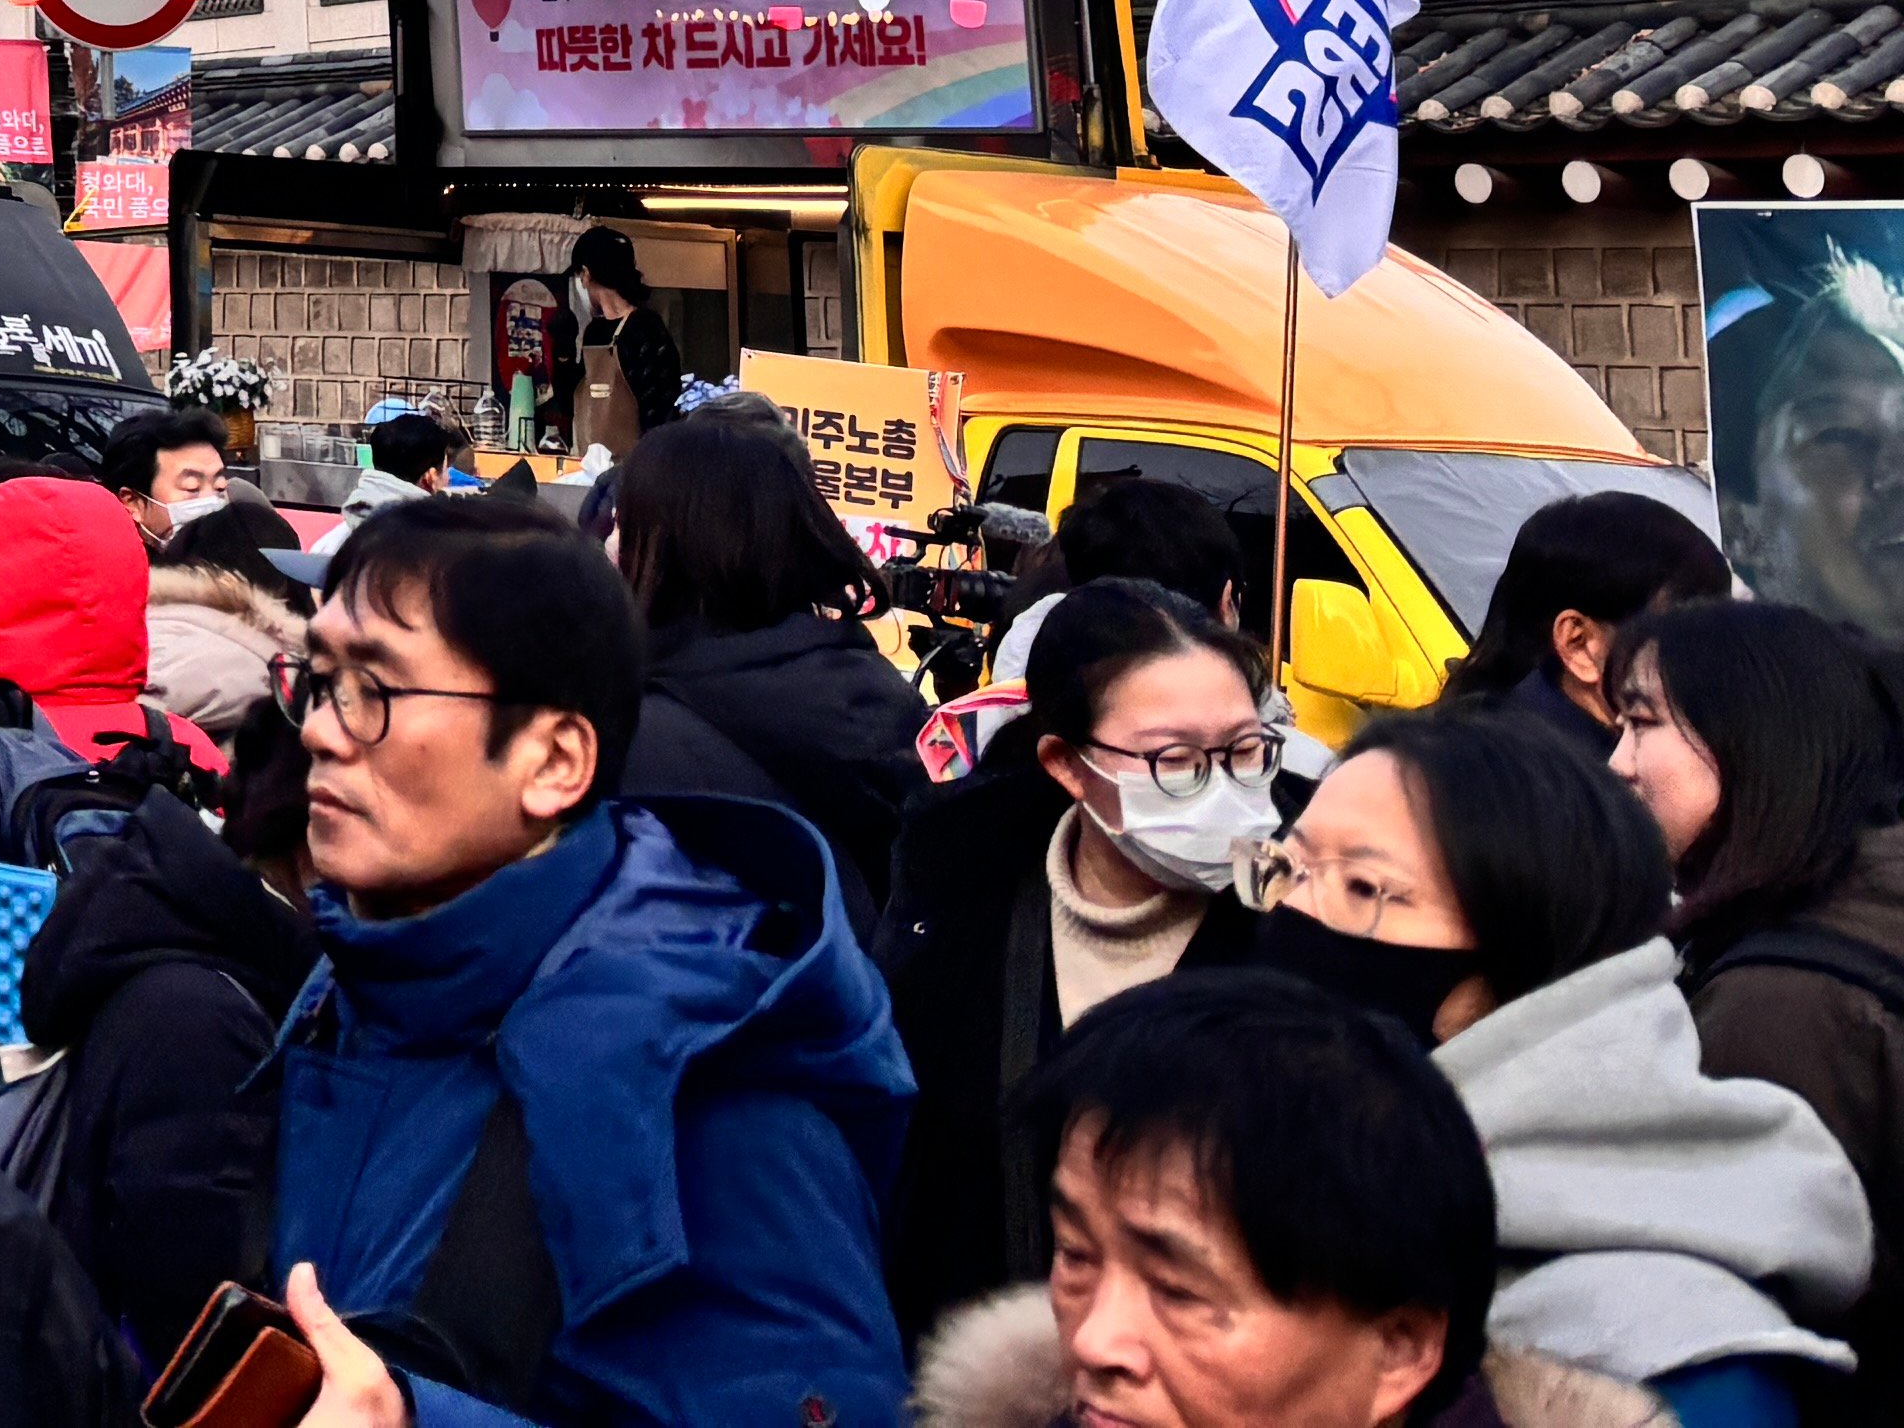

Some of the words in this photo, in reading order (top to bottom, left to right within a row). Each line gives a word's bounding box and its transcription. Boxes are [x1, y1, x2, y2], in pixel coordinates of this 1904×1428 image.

[535, 23, 633, 72] 따뜻한
[641, 21, 674, 71] 차
[685, 17, 792, 70] 드시고
[803, 15, 927, 67] 가세요!
[81, 171, 154, 194] 청와대,
[129, 197, 170, 219] 품으
[812, 459, 914, 509] 울본부
